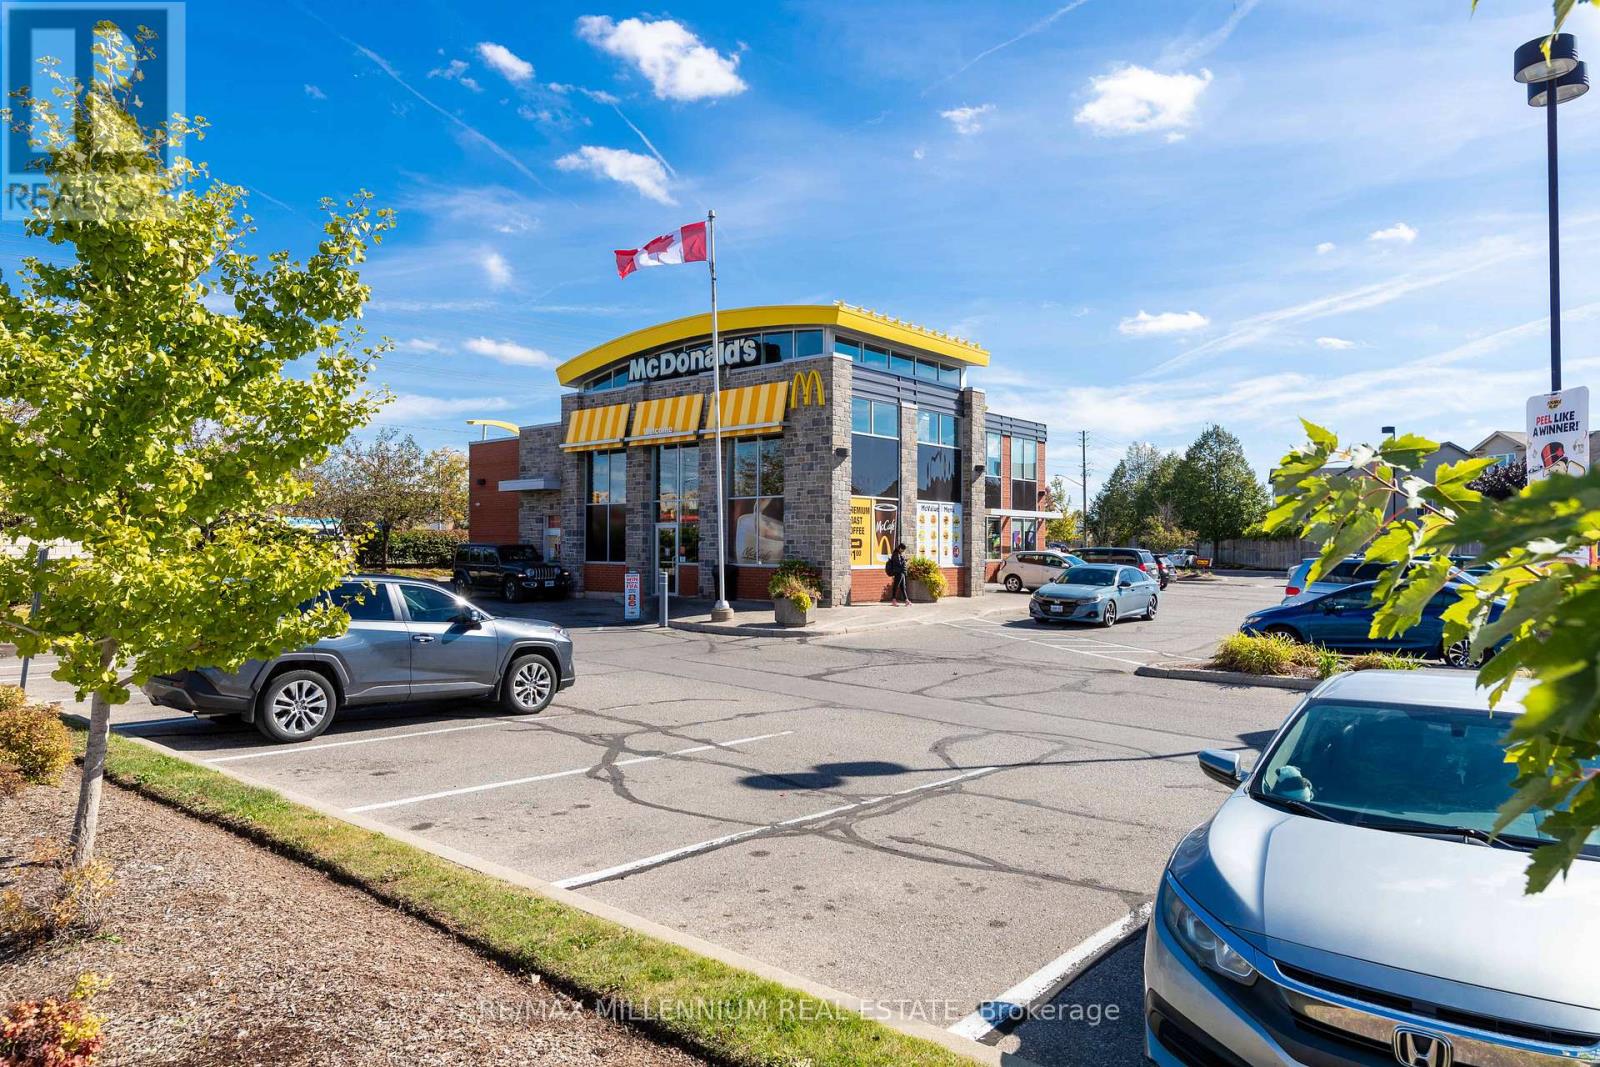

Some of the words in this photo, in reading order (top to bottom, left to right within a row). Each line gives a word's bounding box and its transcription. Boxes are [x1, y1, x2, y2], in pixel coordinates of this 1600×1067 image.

[628, 337, 757, 381] McDonald's
[1536, 414, 1552, 426] PEEL
[1554, 410, 1575, 423] LIKE
[1532, 427, 1539, 438] A
[1539, 420, 1579, 436] WINNER!
